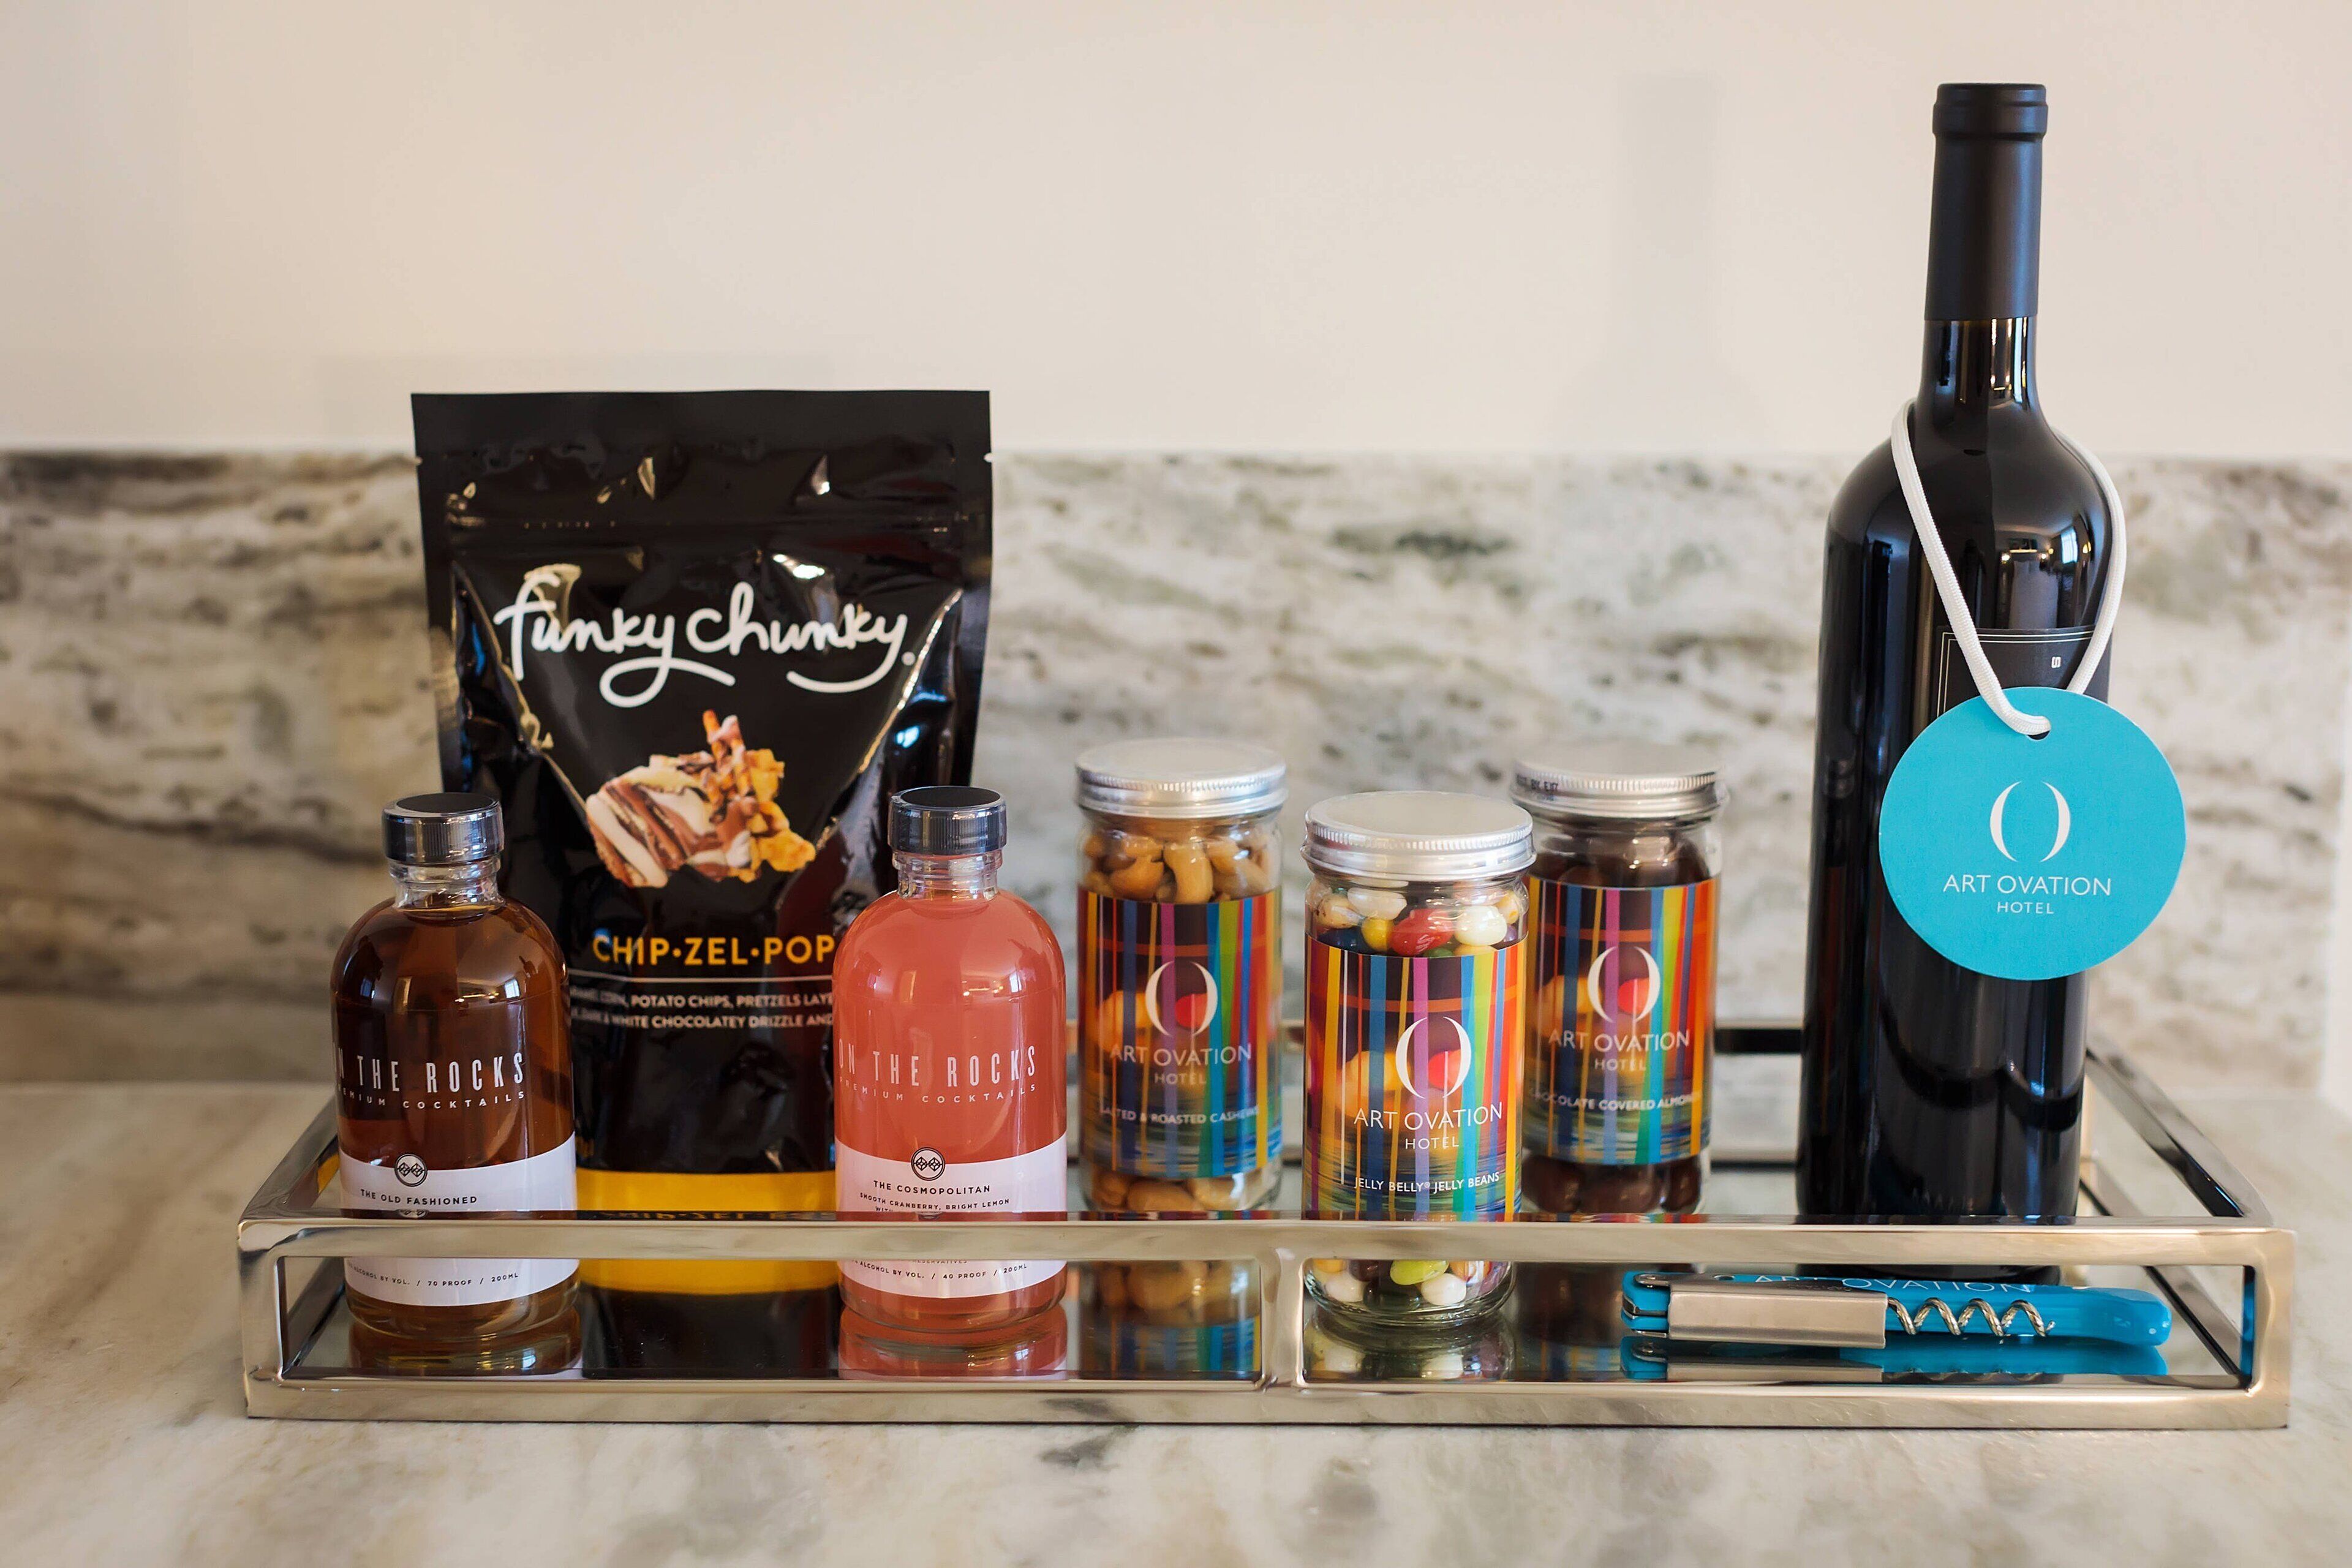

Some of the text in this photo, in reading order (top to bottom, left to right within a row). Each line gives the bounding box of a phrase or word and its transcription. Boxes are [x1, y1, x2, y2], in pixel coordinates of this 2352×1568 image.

[494, 573, 734, 707] funky
[1943, 874, 2111, 896] ART OVATION
[1997, 901, 2054, 914] HOTEL
[631, 994, 686, 1008] POTATO
[688, 994, 734, 1009] CHIPS,
[737, 993, 801, 1008] PRETZELS
[651, 1015, 746, 1029] CHOCOLATEY
[748, 1014, 804, 1028] DRIZZLE
[1548, 1028, 1690, 1053] ART OVATION
[1110, 1042, 1252, 1067] ART OVATION
[357, 1055, 399, 1091] THE
[427, 1052, 524, 1093] ROCKS
[873, 1050, 919, 1087] THE
[947, 1046, 1035, 1087] ROCKS
[1594, 1058, 1647, 1072] HOTEL
[1155, 1073, 1207, 1085] HOTEL
[840, 1076, 1036, 1103] PREMIUM COCKTAILS
[403, 1091, 525, 1109] COCKTAILS
[1599, 1099, 1656, 1110] COVERED
[1151, 1114, 1207, 1125] ROASTED
[1354, 1101, 1502, 1131] ART OVATION
[1404, 1137, 1460, 1150] HOTEL
[873, 1180, 991, 1196] THE COSMOPOLITAN
[1354, 1177, 1384, 1191] JELLY
[1433, 1178, 1464, 1194] JELLY
[1468, 1172, 1499, 1188] BEANS
[360, 1188, 478, 1205] THE OLD FASHIONED
[860, 1192, 886, 1204] SMOOTH
[890, 1200, 941, 1211] CRANBERRY,
[982, 1198, 1010, 1208] LEMON
[860, 1261, 889, 1274] ALCOHOL
[1004, 1264, 1027, 1273] 200ML
[491, 1272, 519, 1283] 200ML
